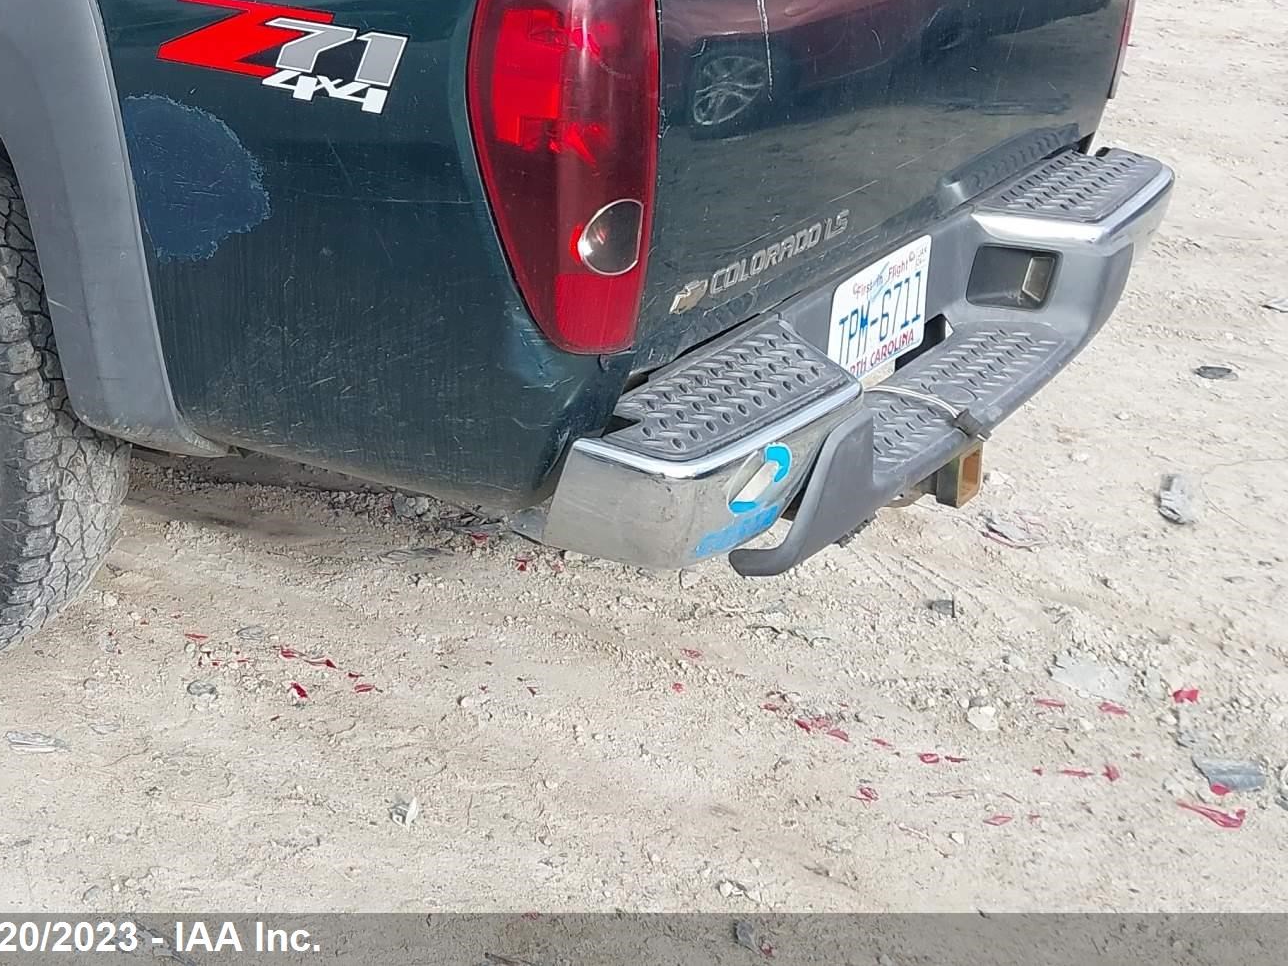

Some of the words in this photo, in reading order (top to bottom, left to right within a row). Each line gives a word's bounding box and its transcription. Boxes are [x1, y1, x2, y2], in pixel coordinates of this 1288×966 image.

[710, 221, 822, 295] COLORADO
[823, 208, 850, 241] LS
[838, 270, 922, 365] TPM-6711
[870, 328, 914, 367] CAROLINA
